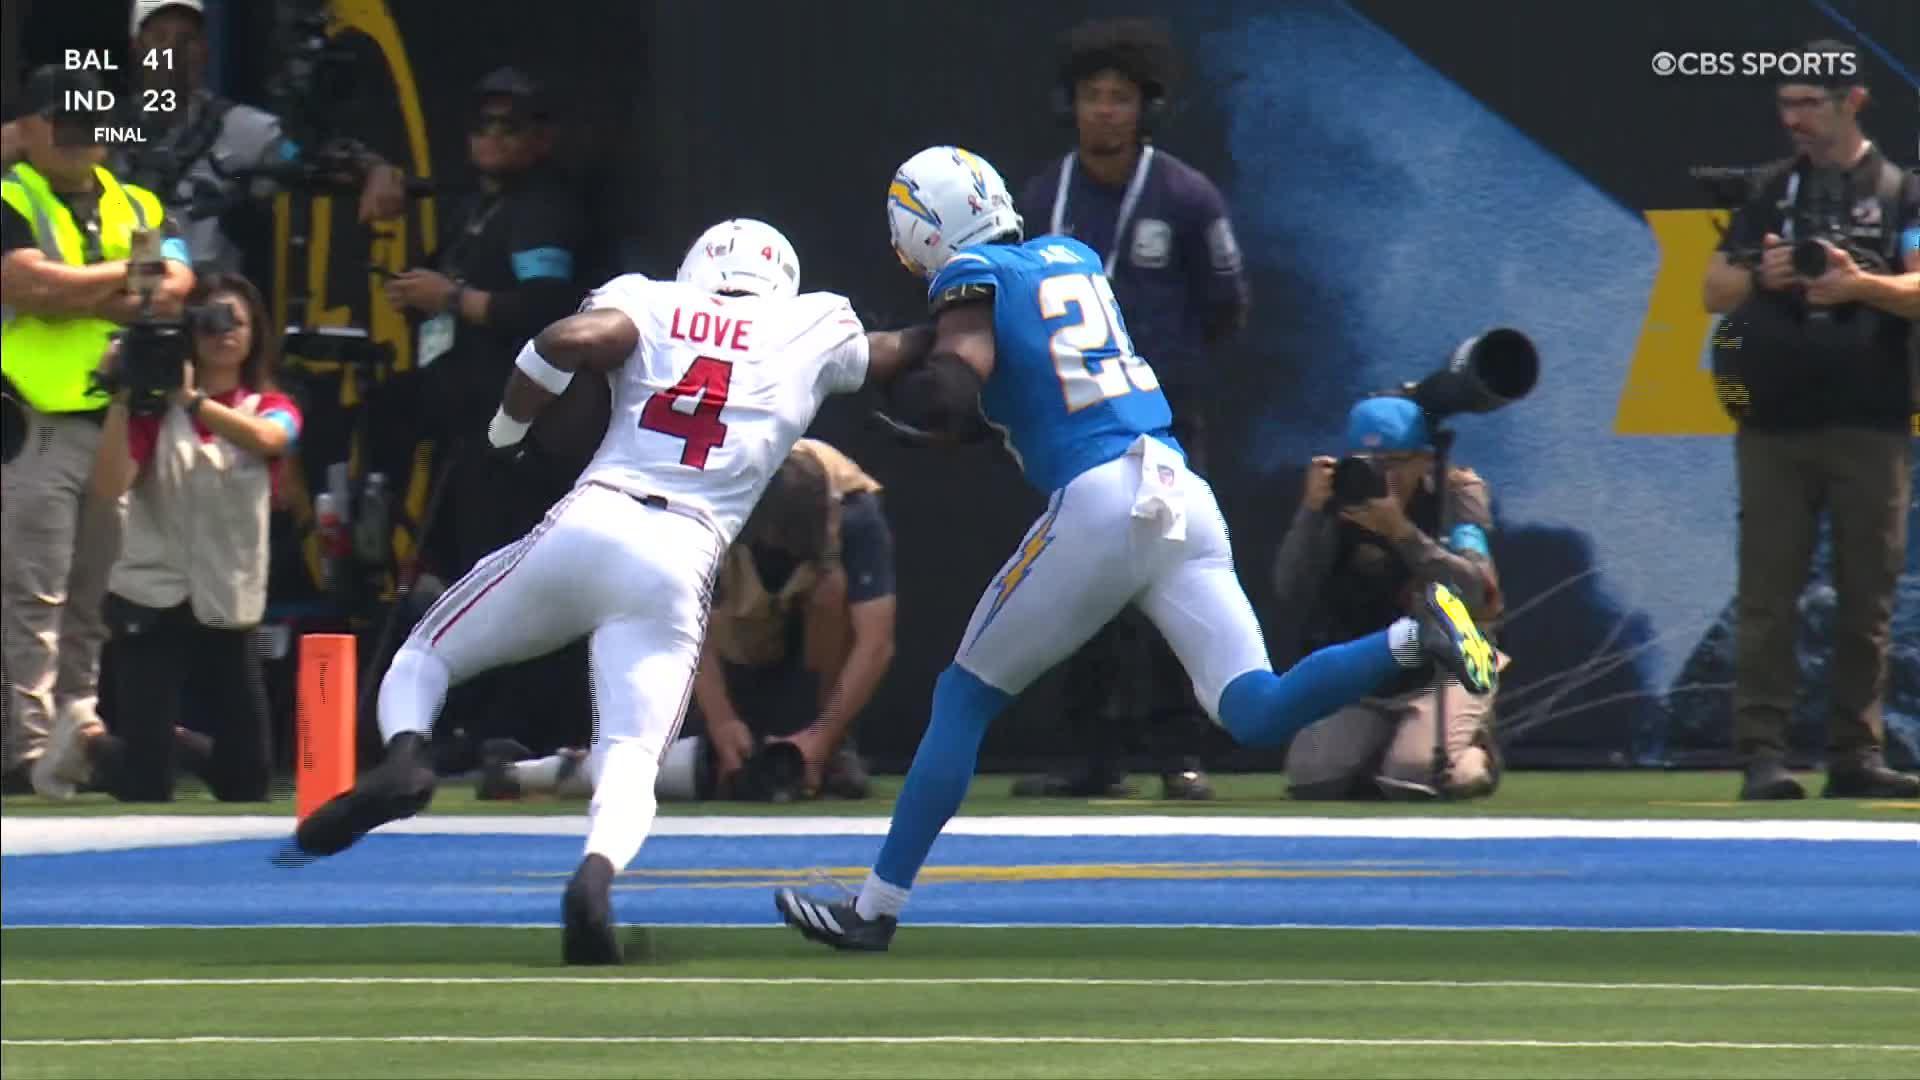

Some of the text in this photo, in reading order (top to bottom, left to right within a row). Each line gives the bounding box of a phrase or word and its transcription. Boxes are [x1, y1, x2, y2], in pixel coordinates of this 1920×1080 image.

[761, 245, 772, 261] 4
[670, 306, 753, 351] LOVE
[638, 354, 734, 473] 4
